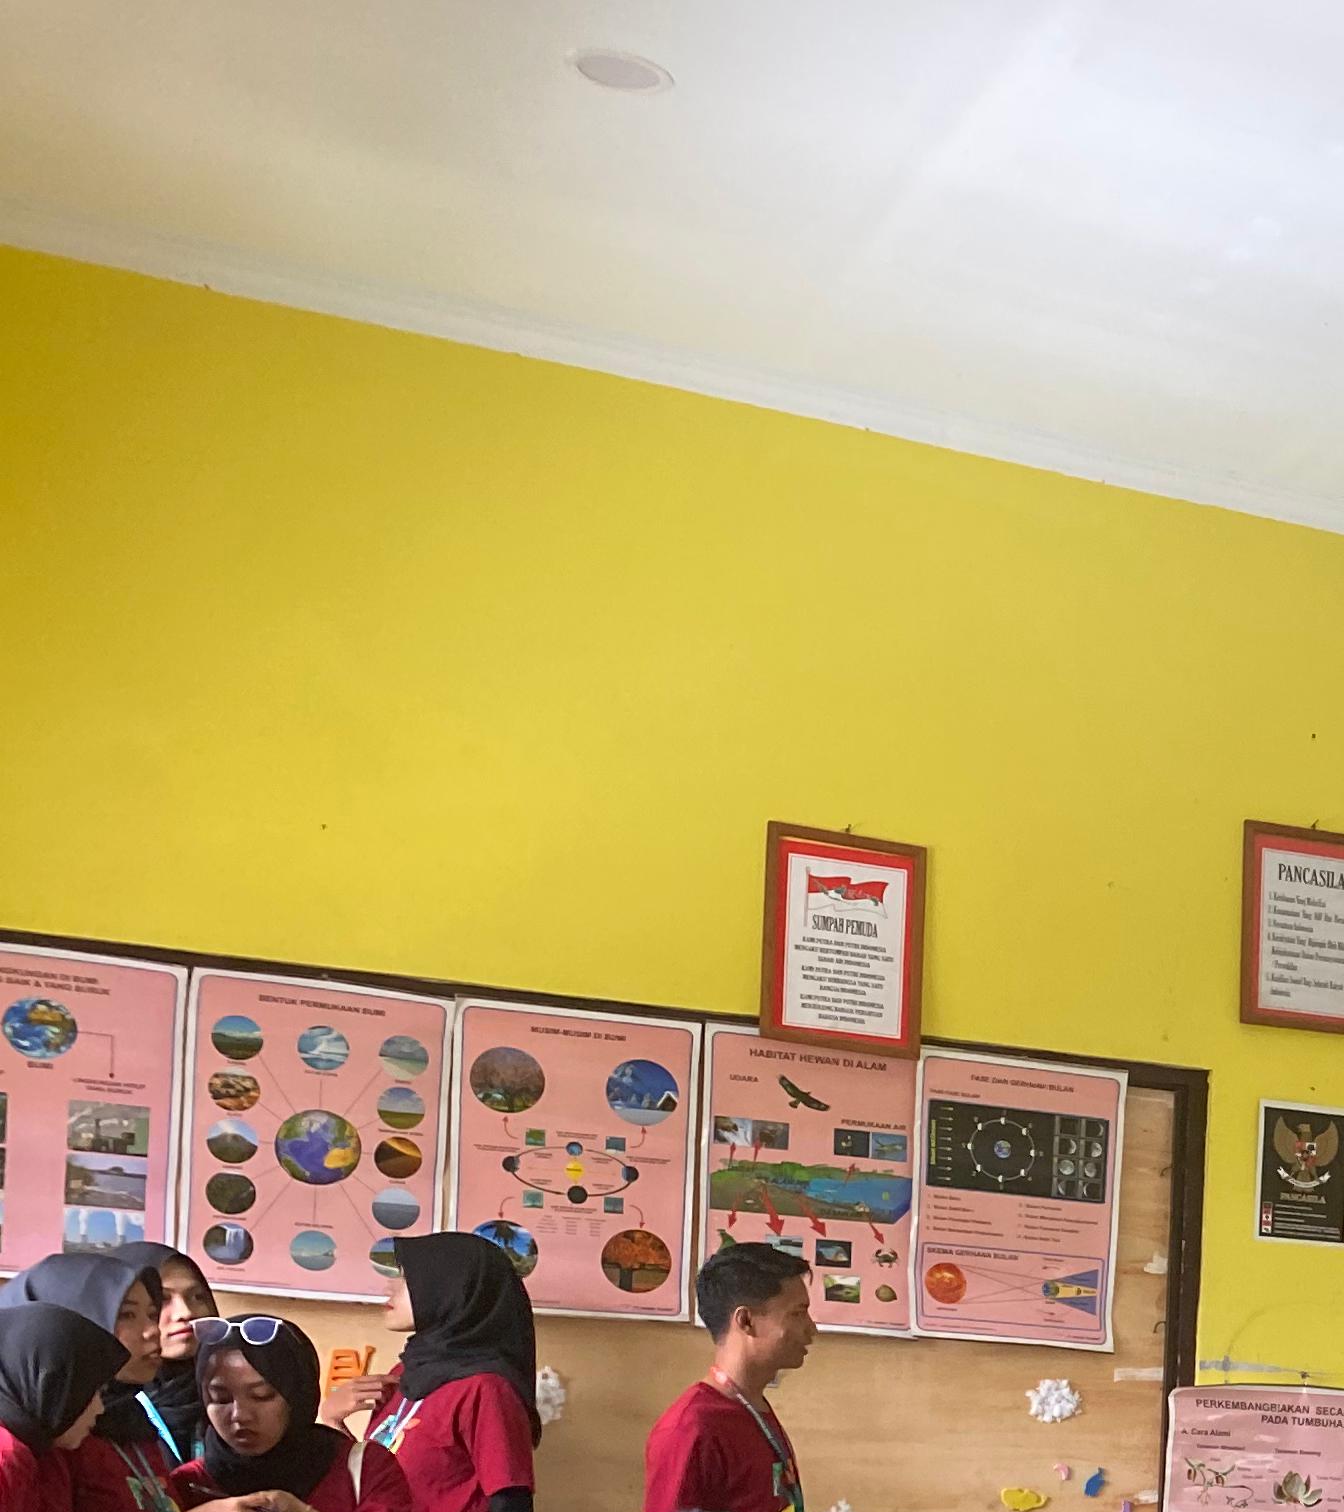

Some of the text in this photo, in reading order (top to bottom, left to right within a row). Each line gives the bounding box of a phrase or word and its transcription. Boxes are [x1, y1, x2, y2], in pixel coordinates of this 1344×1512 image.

[812, 914, 878, 938] SUMPAH PEMUDA
[749, 1049, 887, 1072] HABITAT HEWAN DI ALAM
[729, 1074, 759, 1083] UDARA
[1196, 1399, 1310, 1414] PERKEMBANGBIAKAN
[1261, 1415, 1289, 1425] PADA
[1191, 1428, 1208, 1436] Cara
[1210, 1429, 1231, 1437] Alami
